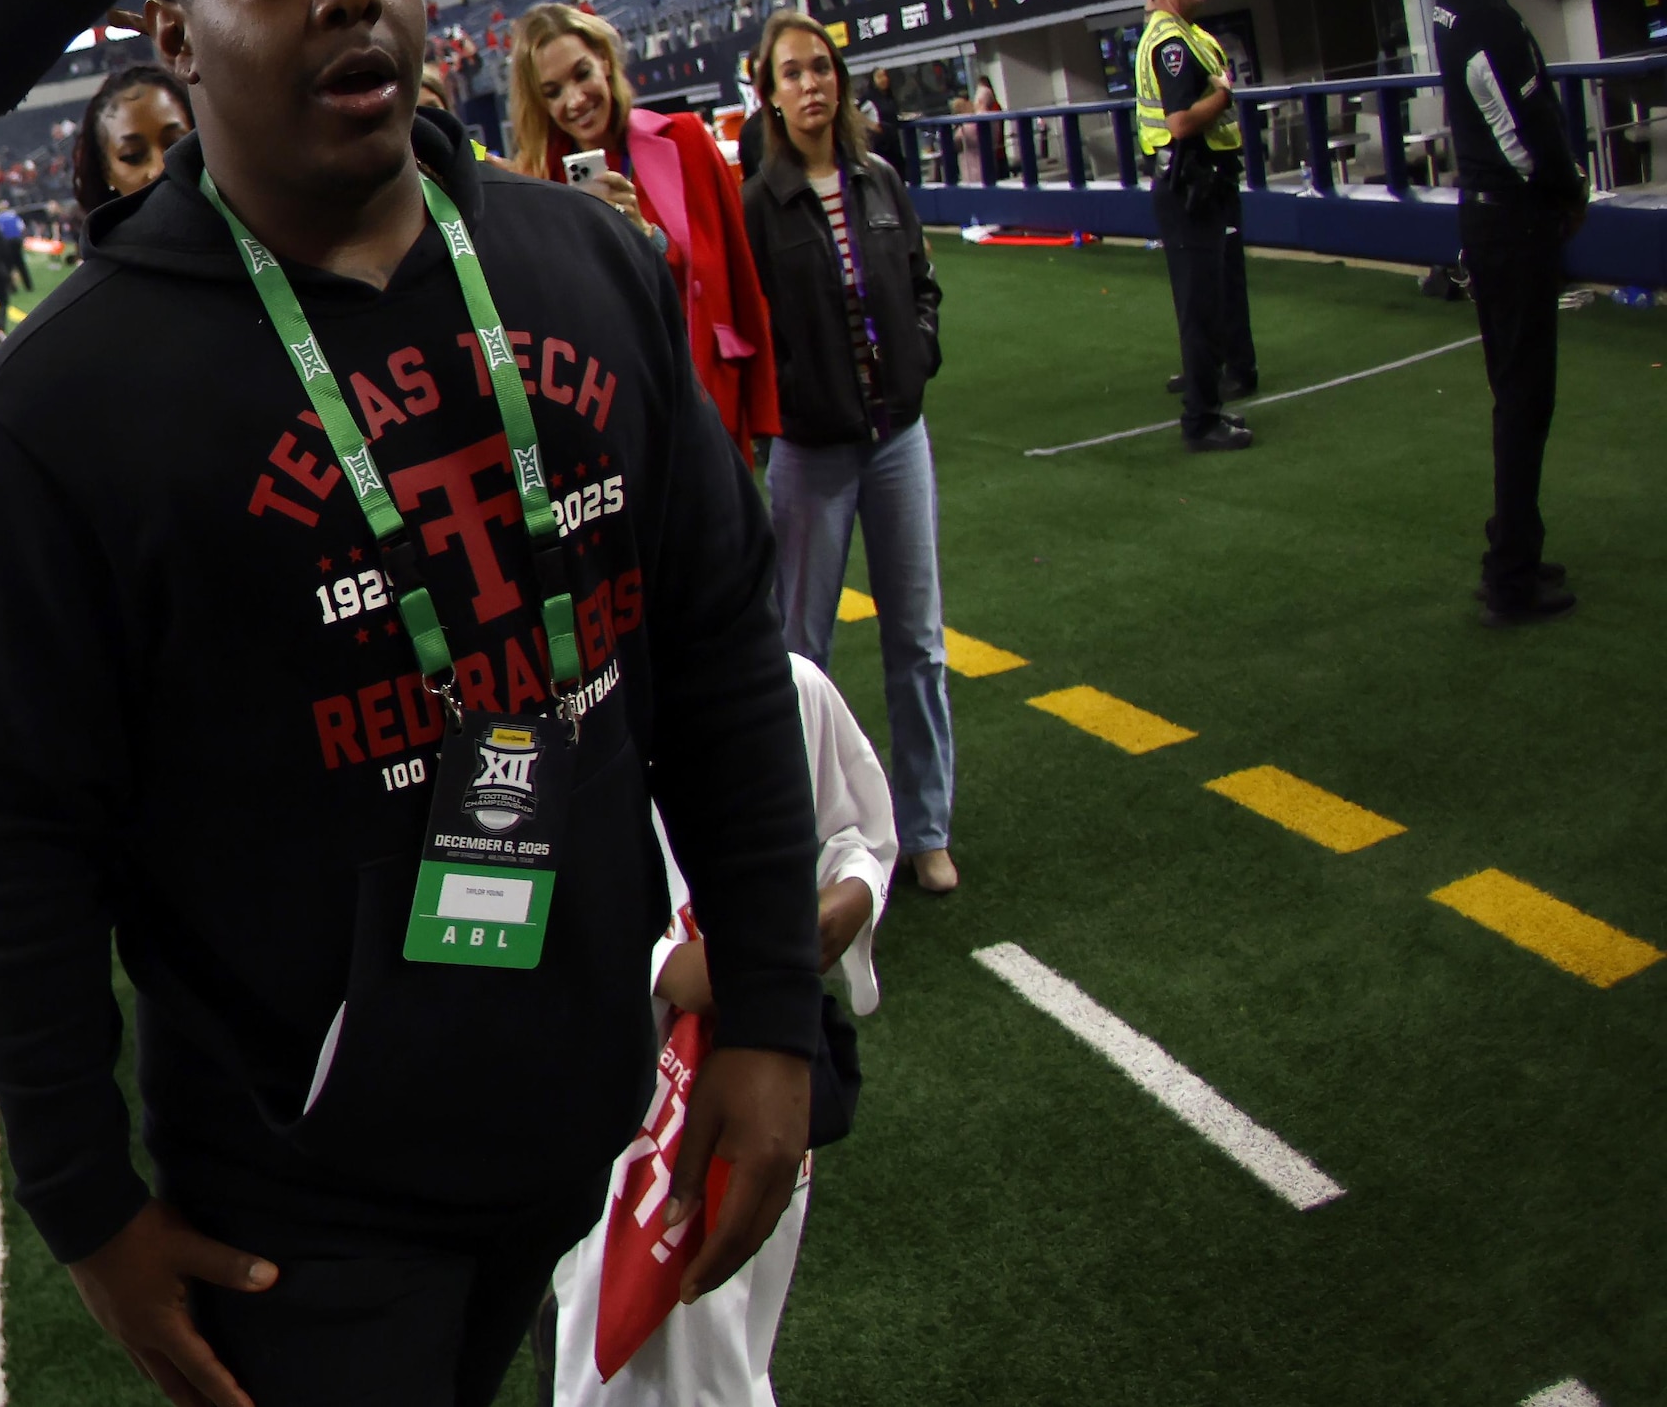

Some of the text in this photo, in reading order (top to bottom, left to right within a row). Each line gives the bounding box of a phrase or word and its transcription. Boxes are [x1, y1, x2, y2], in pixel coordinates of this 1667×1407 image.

[247, 345, 441, 529] TEAS
[548, 474, 625, 538] 2025
[315, 568, 395, 626] 192
[381, 758, 426, 792] 100
[472, 746, 540, 793] XII
[464, 799, 534, 815] CHAMPIONSHIP
[478, 793, 523, 806] FOOTBALL
[434, 833, 551, 856] DECEMBER 6, 2025
[442, 925, 508, 948] A B L
